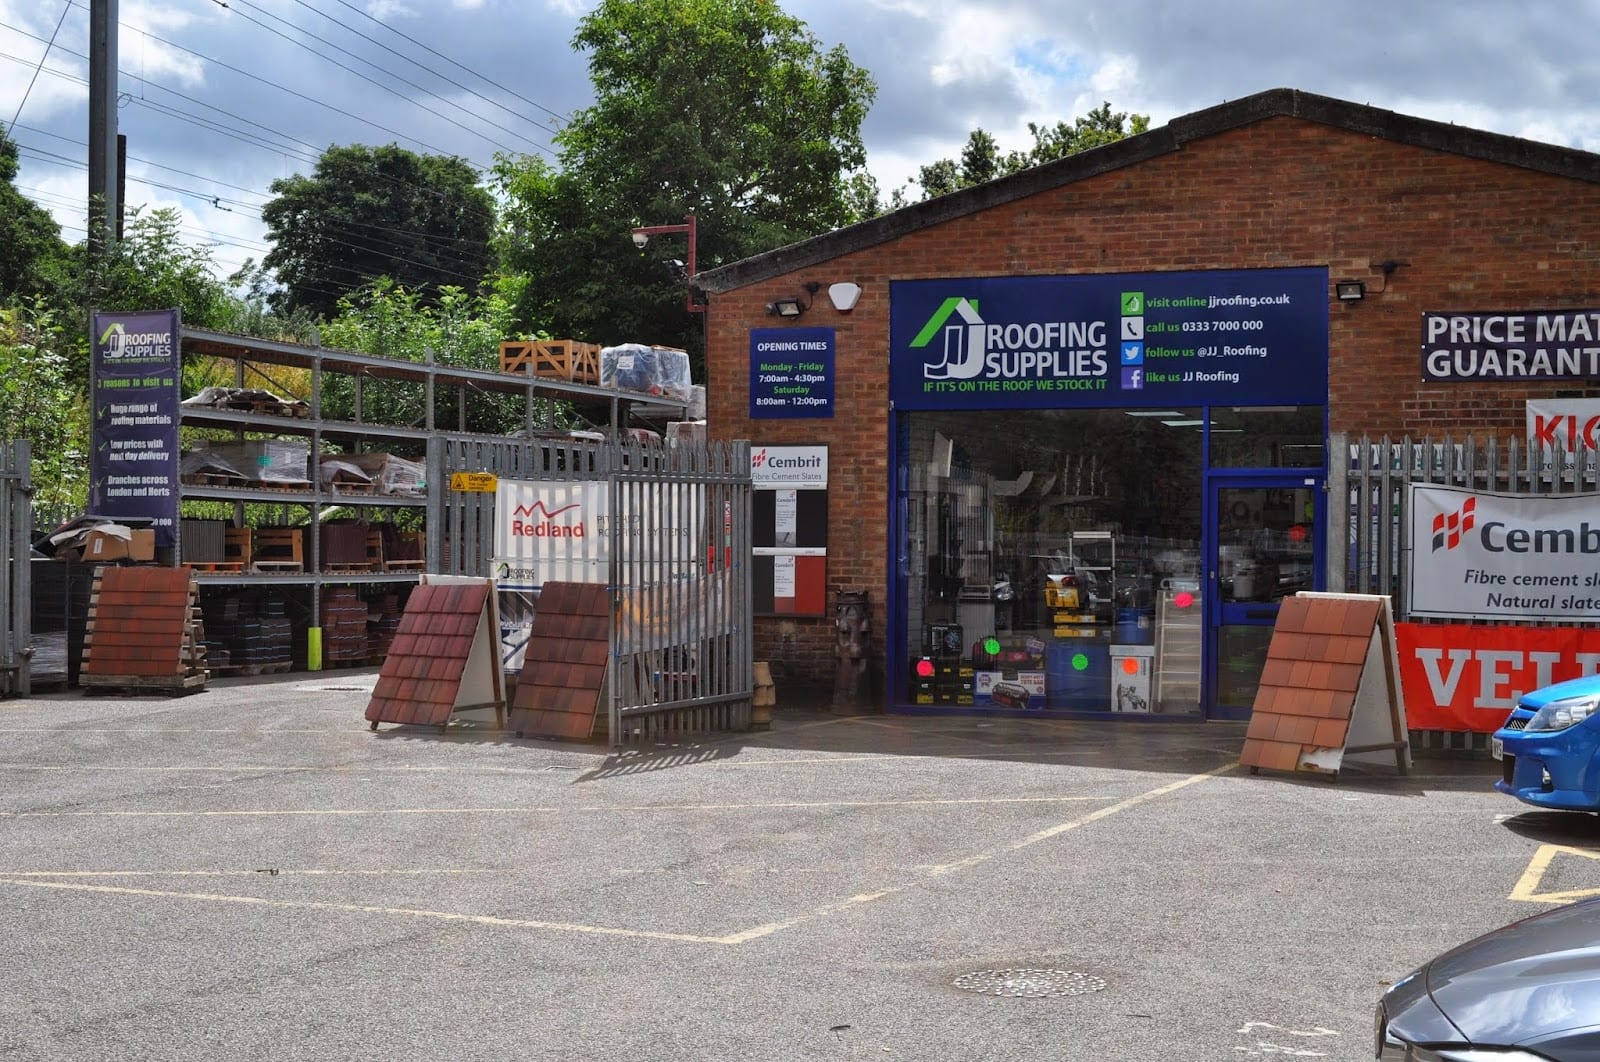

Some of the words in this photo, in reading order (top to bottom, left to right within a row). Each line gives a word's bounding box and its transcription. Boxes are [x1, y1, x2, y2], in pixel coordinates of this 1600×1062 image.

[1147, 297, 1169, 308] visit
[1172, 297, 1207, 307] online
[1208, 294, 1290, 309] jjroofing.co.uk
[1146, 323, 1165, 333] call
[1167, 324, 1180, 333] us
[1182, 322, 1210, 332] 0333
[1213, 321, 1240, 331] 7000
[1242, 320, 1264, 331] 000
[1428, 317, 1526, 344] PRICE
[125, 333, 171, 346] ROOFING
[987, 321, 1107, 350] ROOFING
[124, 345, 172, 358] SUPPLIES
[757, 342, 798, 352] OPENING
[800, 342, 827, 351] TIMES
[1146, 347, 1179, 357] follow
[1182, 348, 1195, 357] us
[1197, 346, 1268, 358] @JJ_Roofing
[760, 364, 793, 373] Monday
[799, 363, 824, 372] Friday
[985, 350, 1108, 379] SUPPLIES
[759, 374, 789, 383] 7:00am
[794, 374, 825, 384] 4:30pm
[1146, 372, 1165, 382] like
[1168, 374, 1180, 382] us
[1182, 372, 1193, 382] JJ
[1196, 371, 1239, 383] Roofing
[774, 386, 810, 395] Saturday
[924, 382, 934, 393] IF
[936, 382, 956, 392] IT'S
[959, 382, 976, 391] ON
[977, 381, 1000, 391] THE
[1002, 380, 1034, 391] ROOF
[1036, 380, 1054, 390] WE
[1056, 379, 1093, 390] STOCK
[1096, 379, 1108, 389] IT
[756, 397, 785, 406] 8:00am
[792, 397, 827, 407] 12:00pm
[135, 415, 171, 425] materials
[110, 440, 123, 449] Low
[124, 440, 146, 450] prices
[147, 439, 163, 449] with
[125, 451, 137, 461] day
[138, 451, 169, 461] delivery
[768, 456, 821, 468] Cembrit
[108, 474, 140, 485] Branches
[142, 475, 169, 485] across
[752, 472, 769, 480] Fibre
[771, 472, 799, 480] Cement
[801, 472, 822, 480] Slates
[107, 488, 132, 497] London
[133, 487, 147, 497] and
[148, 487, 170, 497] Herts
[512, 520, 585, 538] Redland
[1480, 521, 1600, 554] Cemb
[1464, 569, 1507, 585] Fibre
[1513, 573, 1579, 587] cement
[1486, 593, 1556, 609] Natural
[1415, 648, 1600, 709] VE
